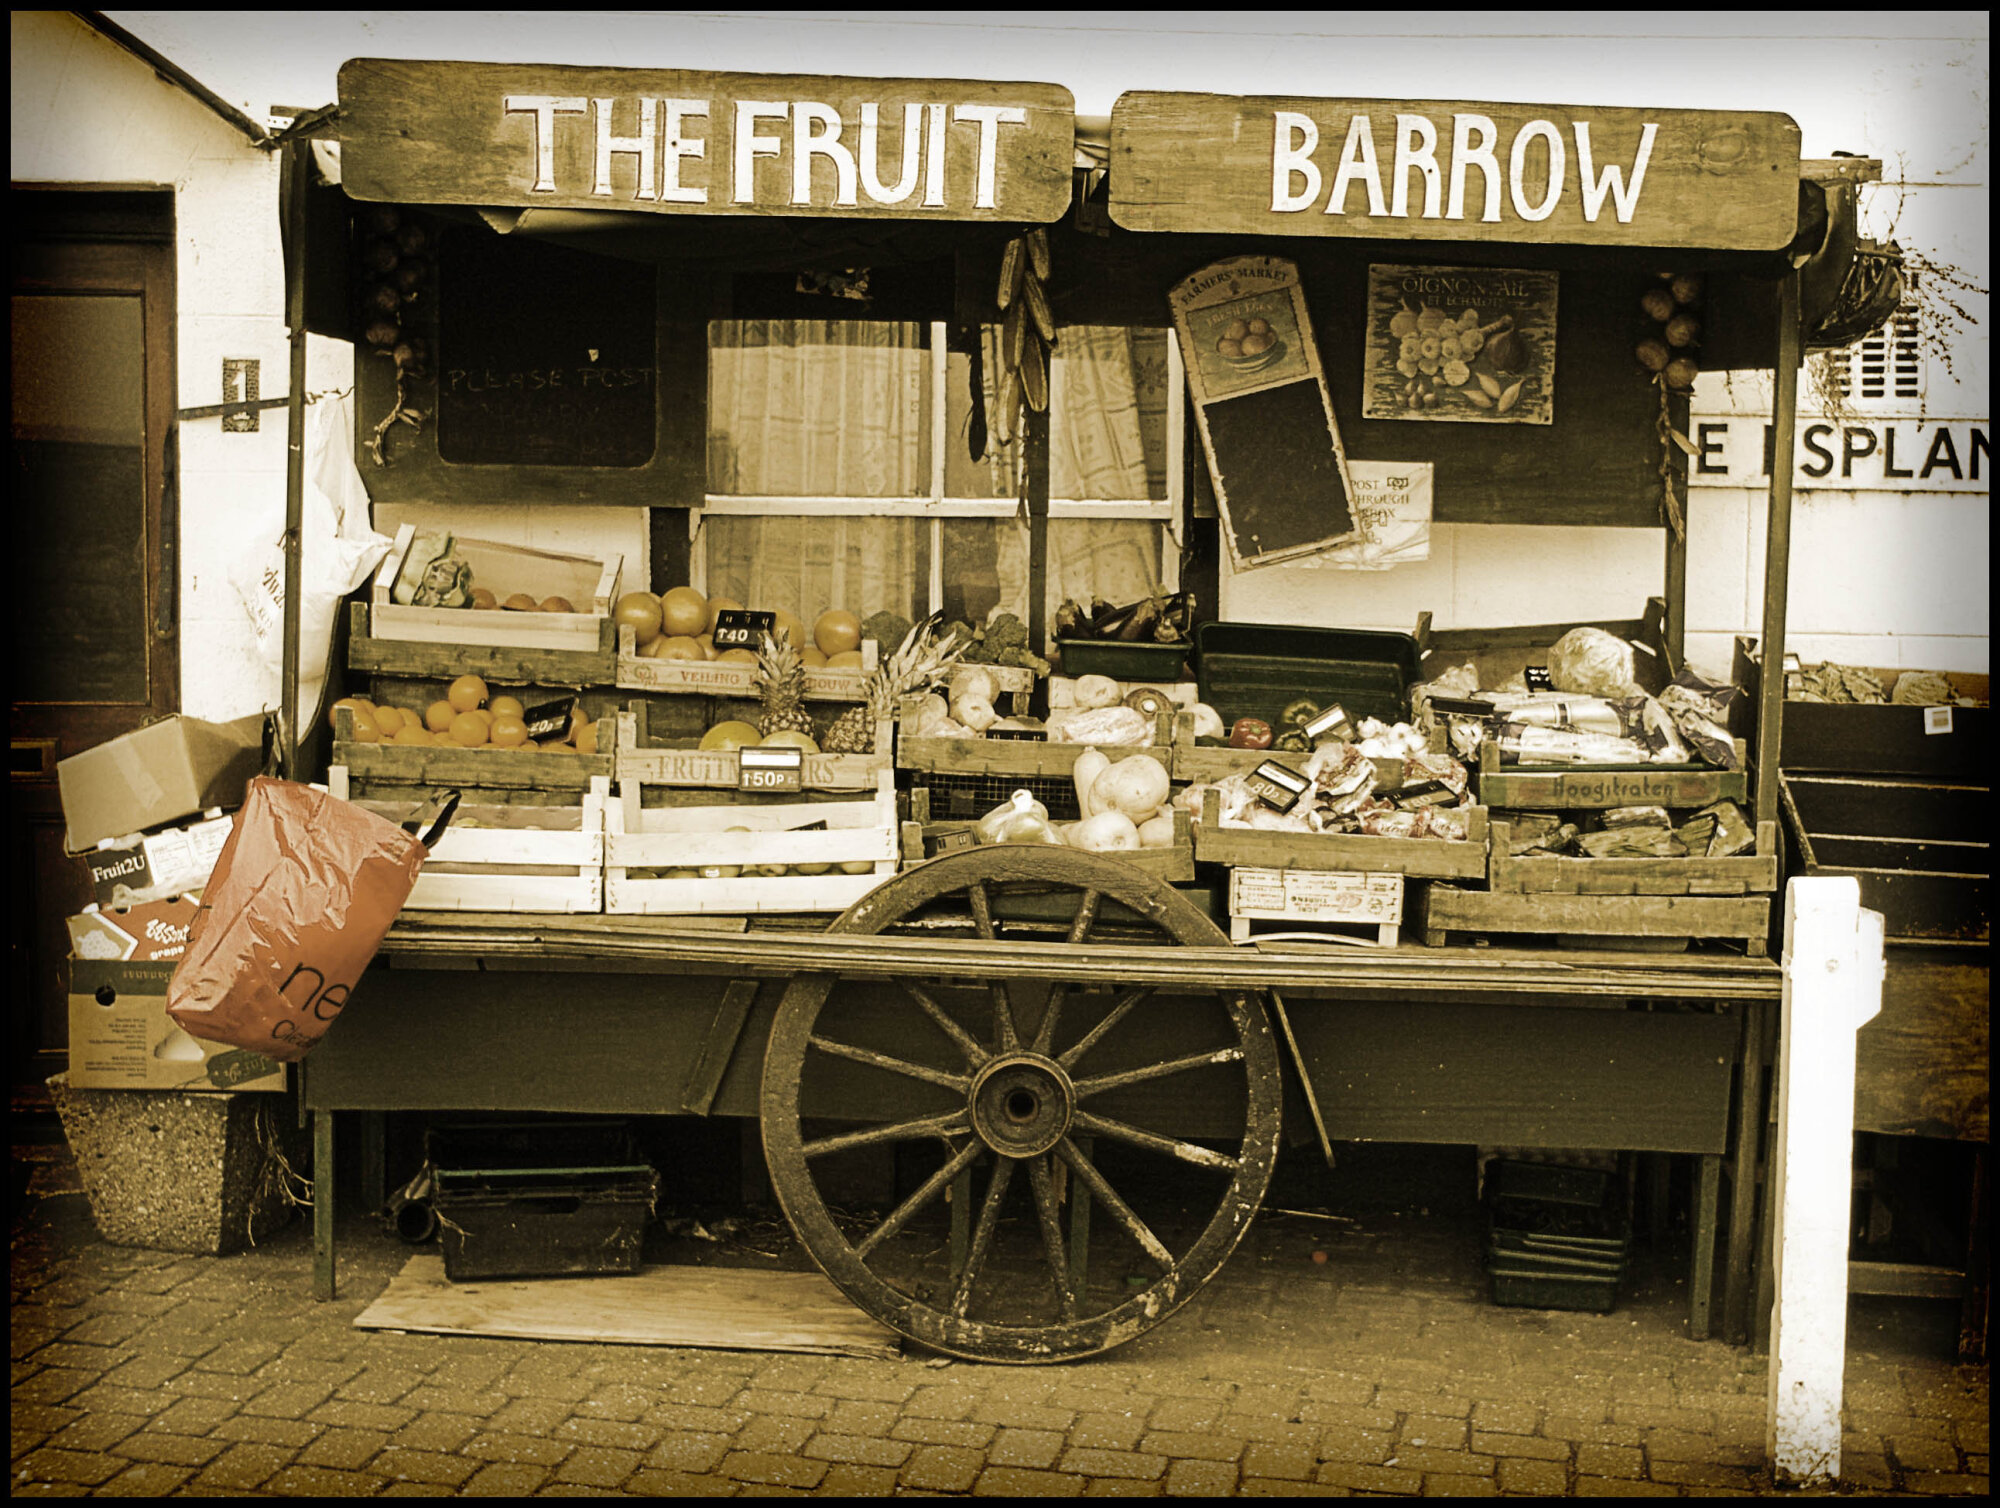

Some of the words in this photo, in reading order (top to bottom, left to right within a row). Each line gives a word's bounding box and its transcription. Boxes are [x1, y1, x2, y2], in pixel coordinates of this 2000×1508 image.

[505, 94, 709, 205] THE
[730, 100, 1027, 210] FRUIT
[1270, 110, 1660, 224] BARROW
[1237, 268, 1289, 283] MARKET
[680, 670, 740, 685] VEILING
[1552, 774, 1674, 802] Hoogstraten
[92, 854, 146, 883] Fruit2U
